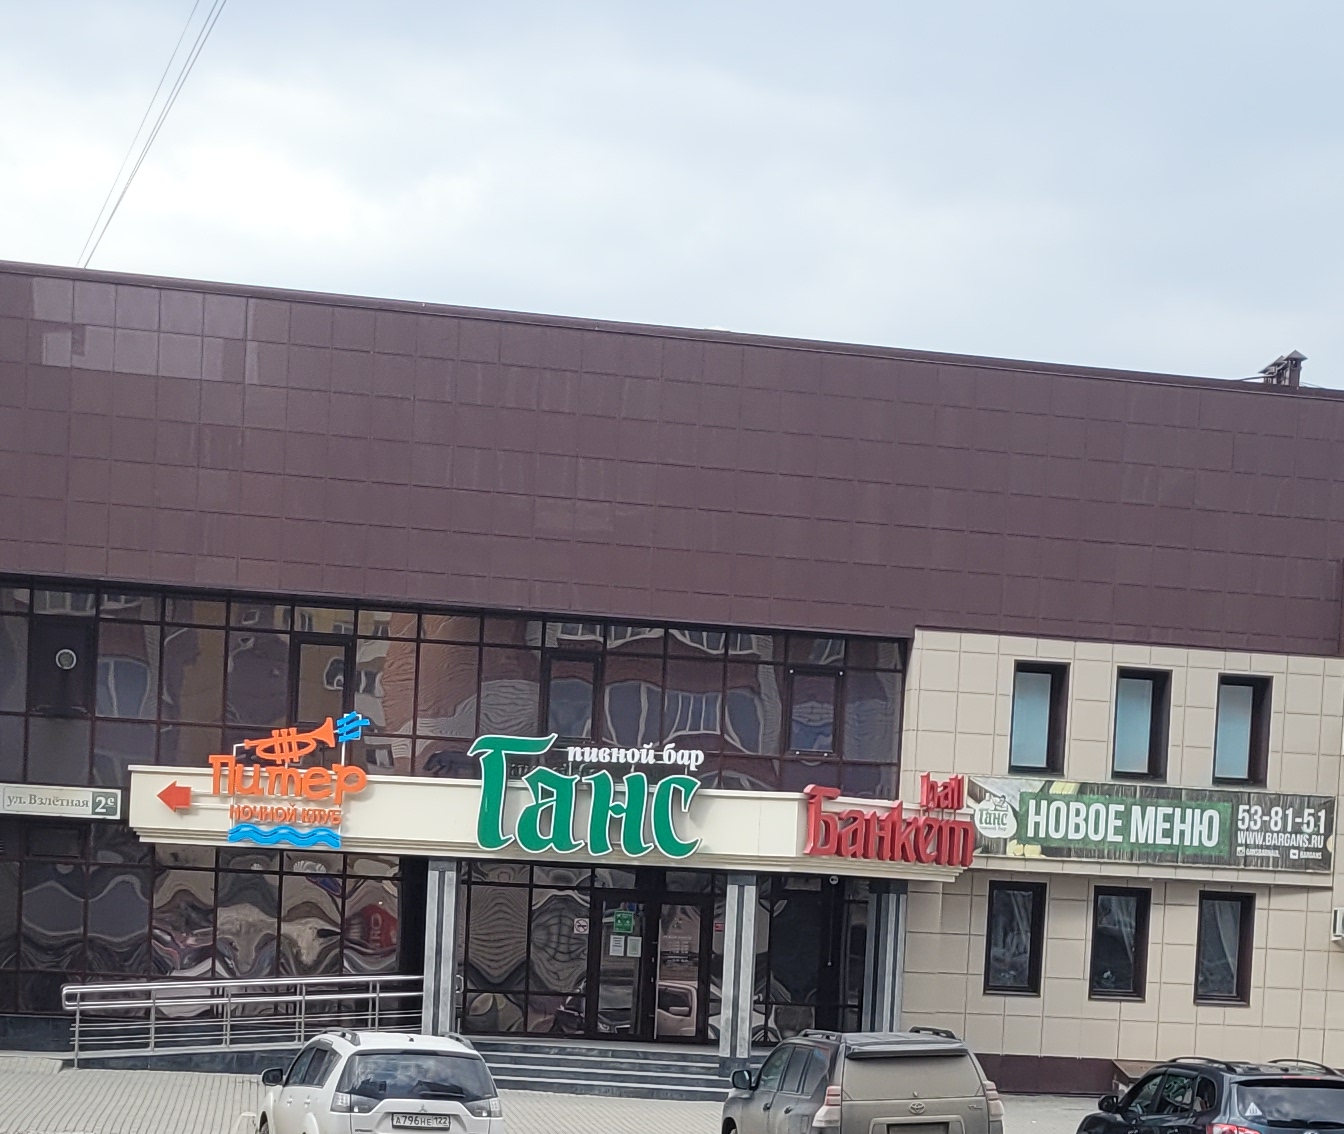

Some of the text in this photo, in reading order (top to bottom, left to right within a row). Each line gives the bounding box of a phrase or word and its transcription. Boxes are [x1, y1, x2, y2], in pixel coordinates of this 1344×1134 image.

[567, 741, 705, 772] пивной бар
[208, 754, 368, 806] Питер
[920, 771, 965, 811] hall
[6, 793, 27, 807] ул.
[28, 793, 90, 809] Взлётная
[467, 732, 703, 860] Ганс
[229, 802, 343, 826] НОЧНОЙ КЛУБ
[802, 784, 976, 868] Банкет
[978, 807, 1009, 826] Ганс
[1027, 799, 1220, 848] НОВОЕ МЕНЮ
[1237, 804, 1326, 834] 53-81-51
[1237, 830, 1325, 849] WWW.BARGANS.RU
[395, 1115, 448, 1126] А796НЕ 122
